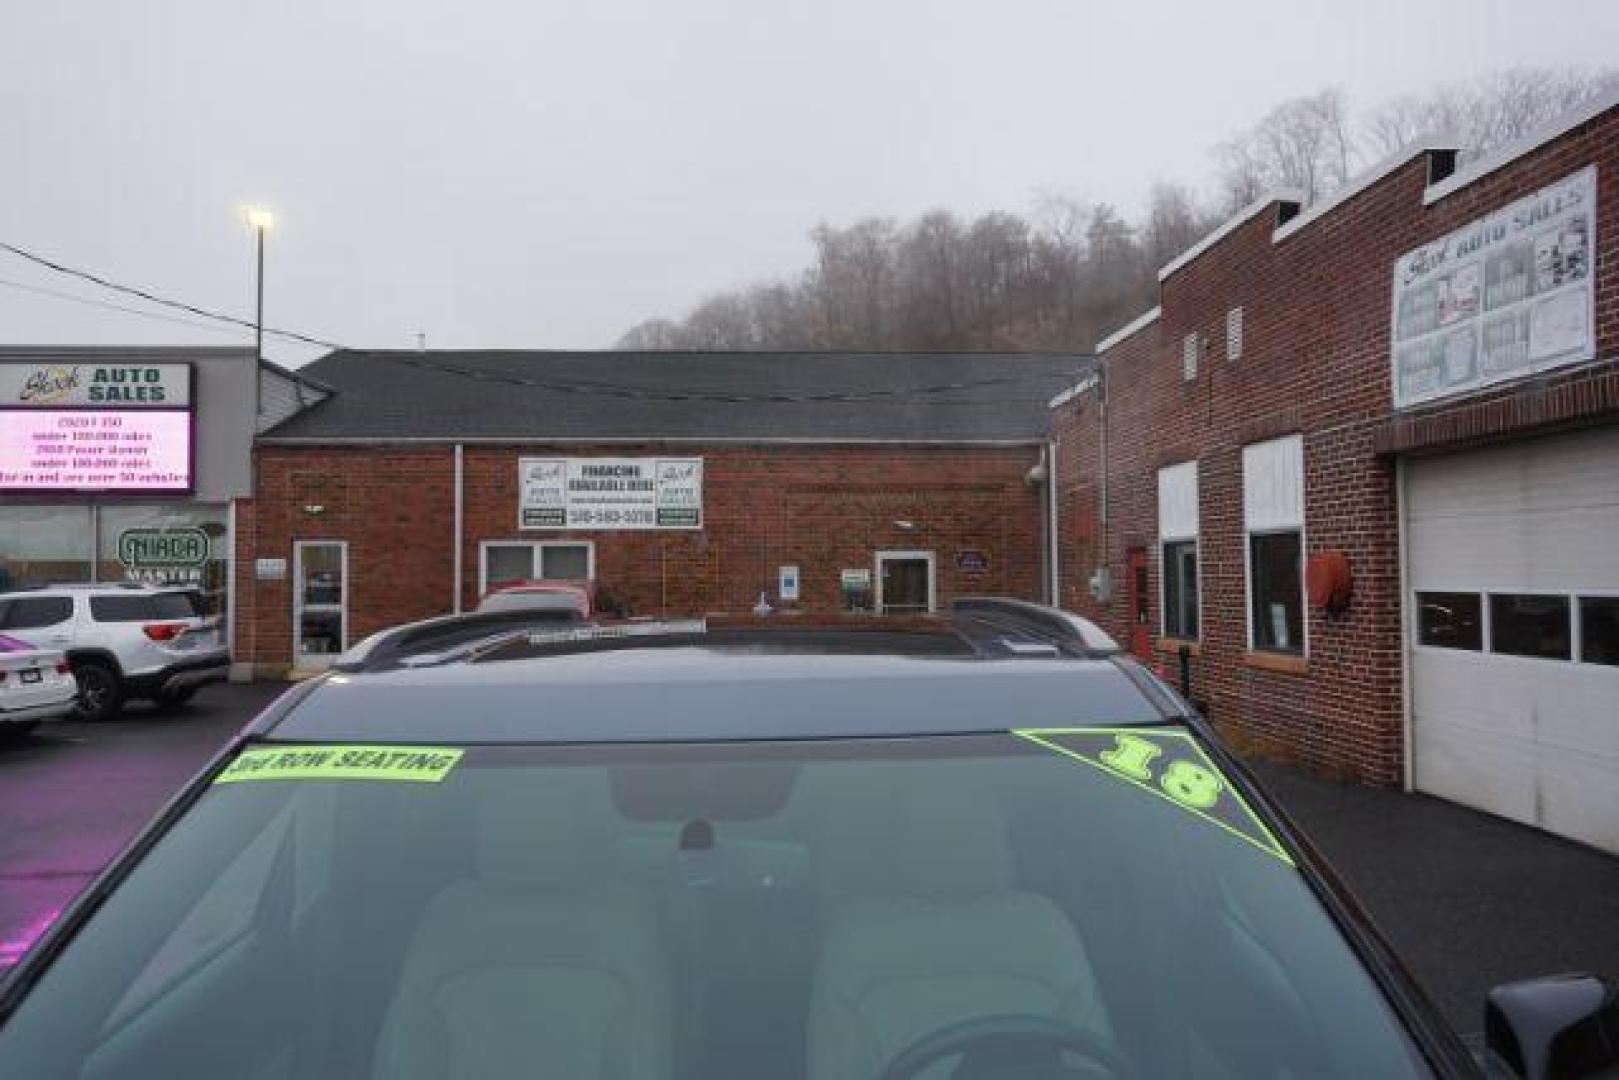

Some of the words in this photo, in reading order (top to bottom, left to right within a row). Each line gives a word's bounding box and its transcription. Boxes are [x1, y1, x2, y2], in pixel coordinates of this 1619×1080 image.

[93, 368, 160, 382] AUTO
[88, 386, 165, 401] SALES
[278, 750, 336, 770] ROW
[335, 750, 454, 771] SEATING
[1100, 733, 1222, 808] 18
